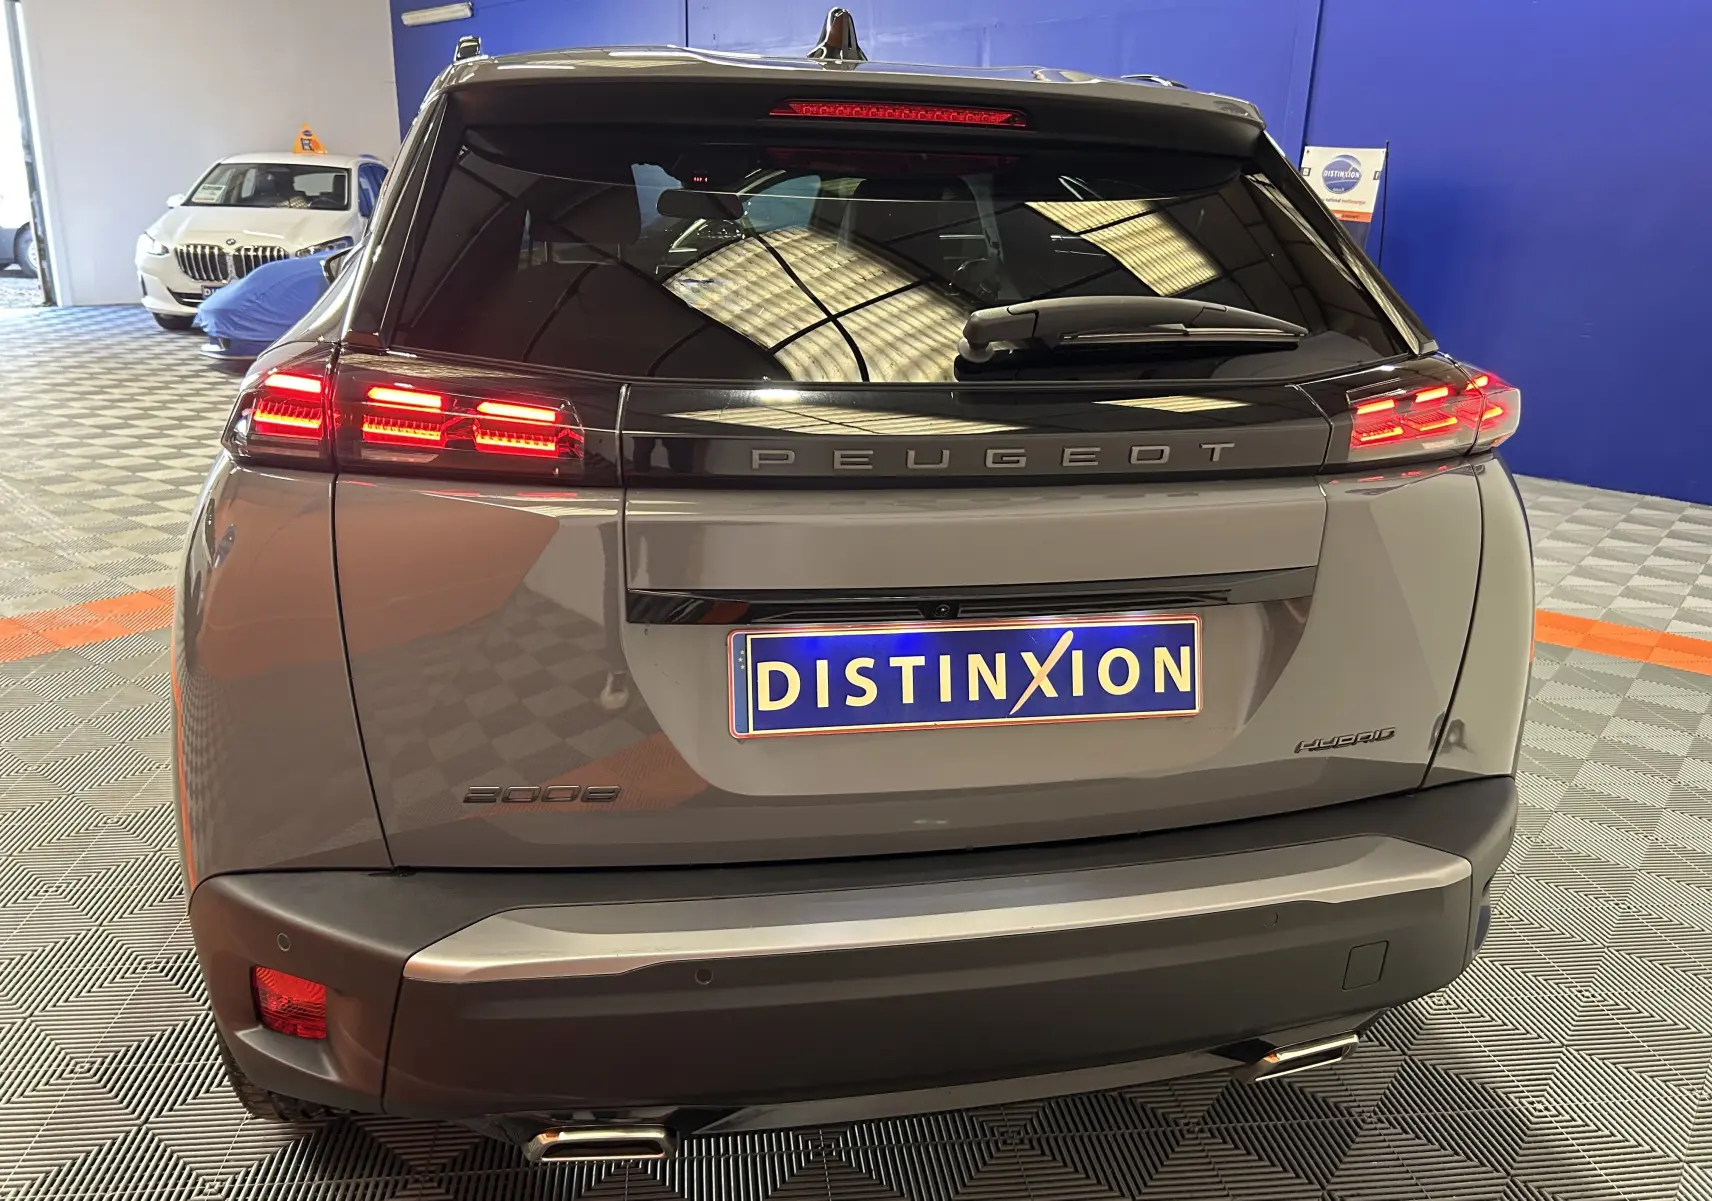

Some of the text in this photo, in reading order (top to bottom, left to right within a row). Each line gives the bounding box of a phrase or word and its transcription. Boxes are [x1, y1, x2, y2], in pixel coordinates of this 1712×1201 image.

[752, 442, 1235, 470] PEUGEOT
[756, 629, 1192, 715] DISTINXION
[1294, 726, 1395, 754] HYBRID
[462, 785, 621, 804] 2008
